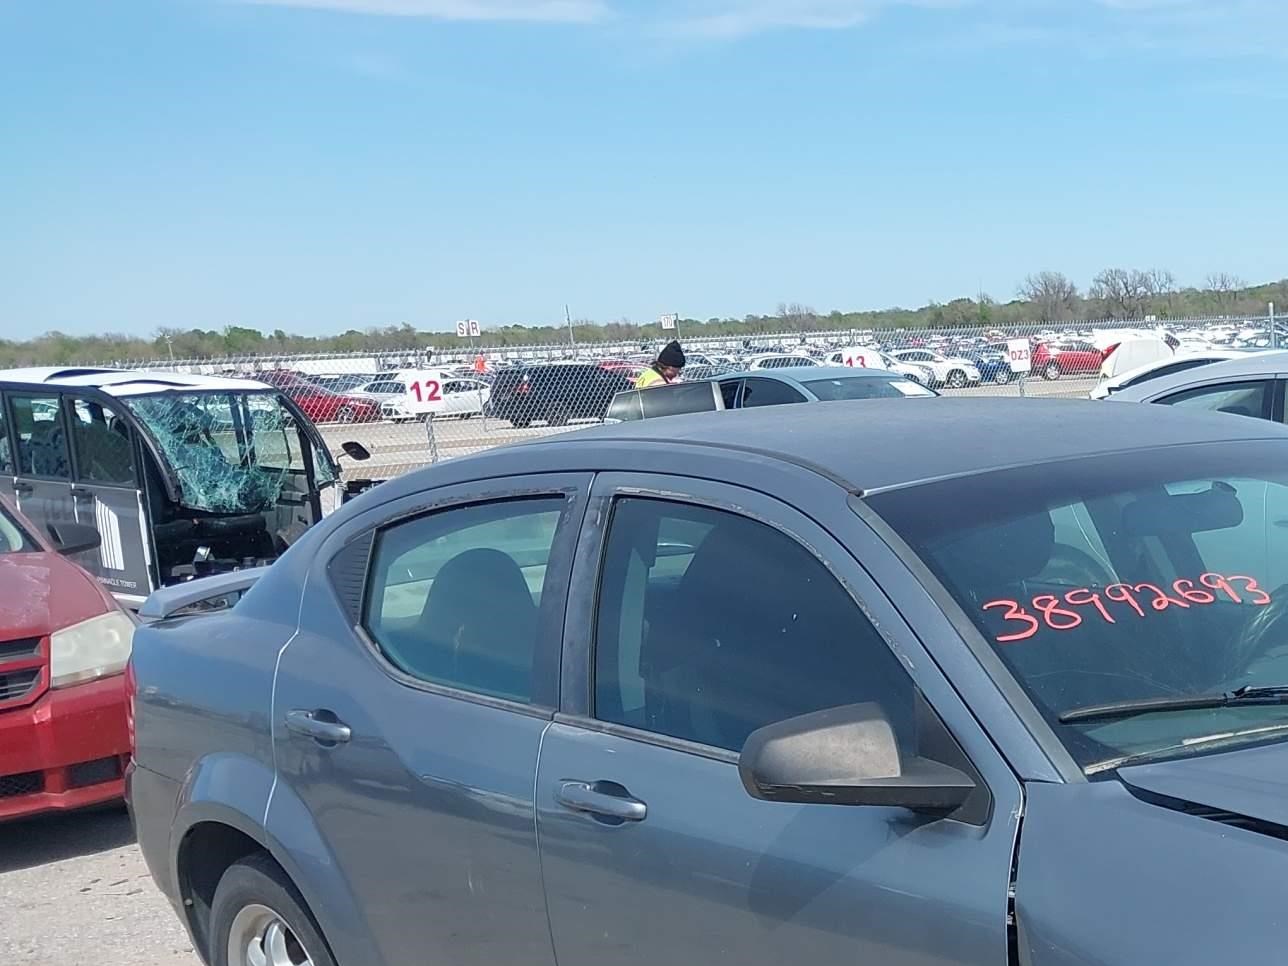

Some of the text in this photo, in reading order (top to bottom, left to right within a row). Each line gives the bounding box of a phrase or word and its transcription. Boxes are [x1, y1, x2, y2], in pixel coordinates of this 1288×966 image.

[457, 322, 465, 335] S
[470, 321, 479, 335] R
[409, 380, 442, 402] 12
[119, 579, 137, 589] TOWER
[982, 572, 1273, 642] 38992693
